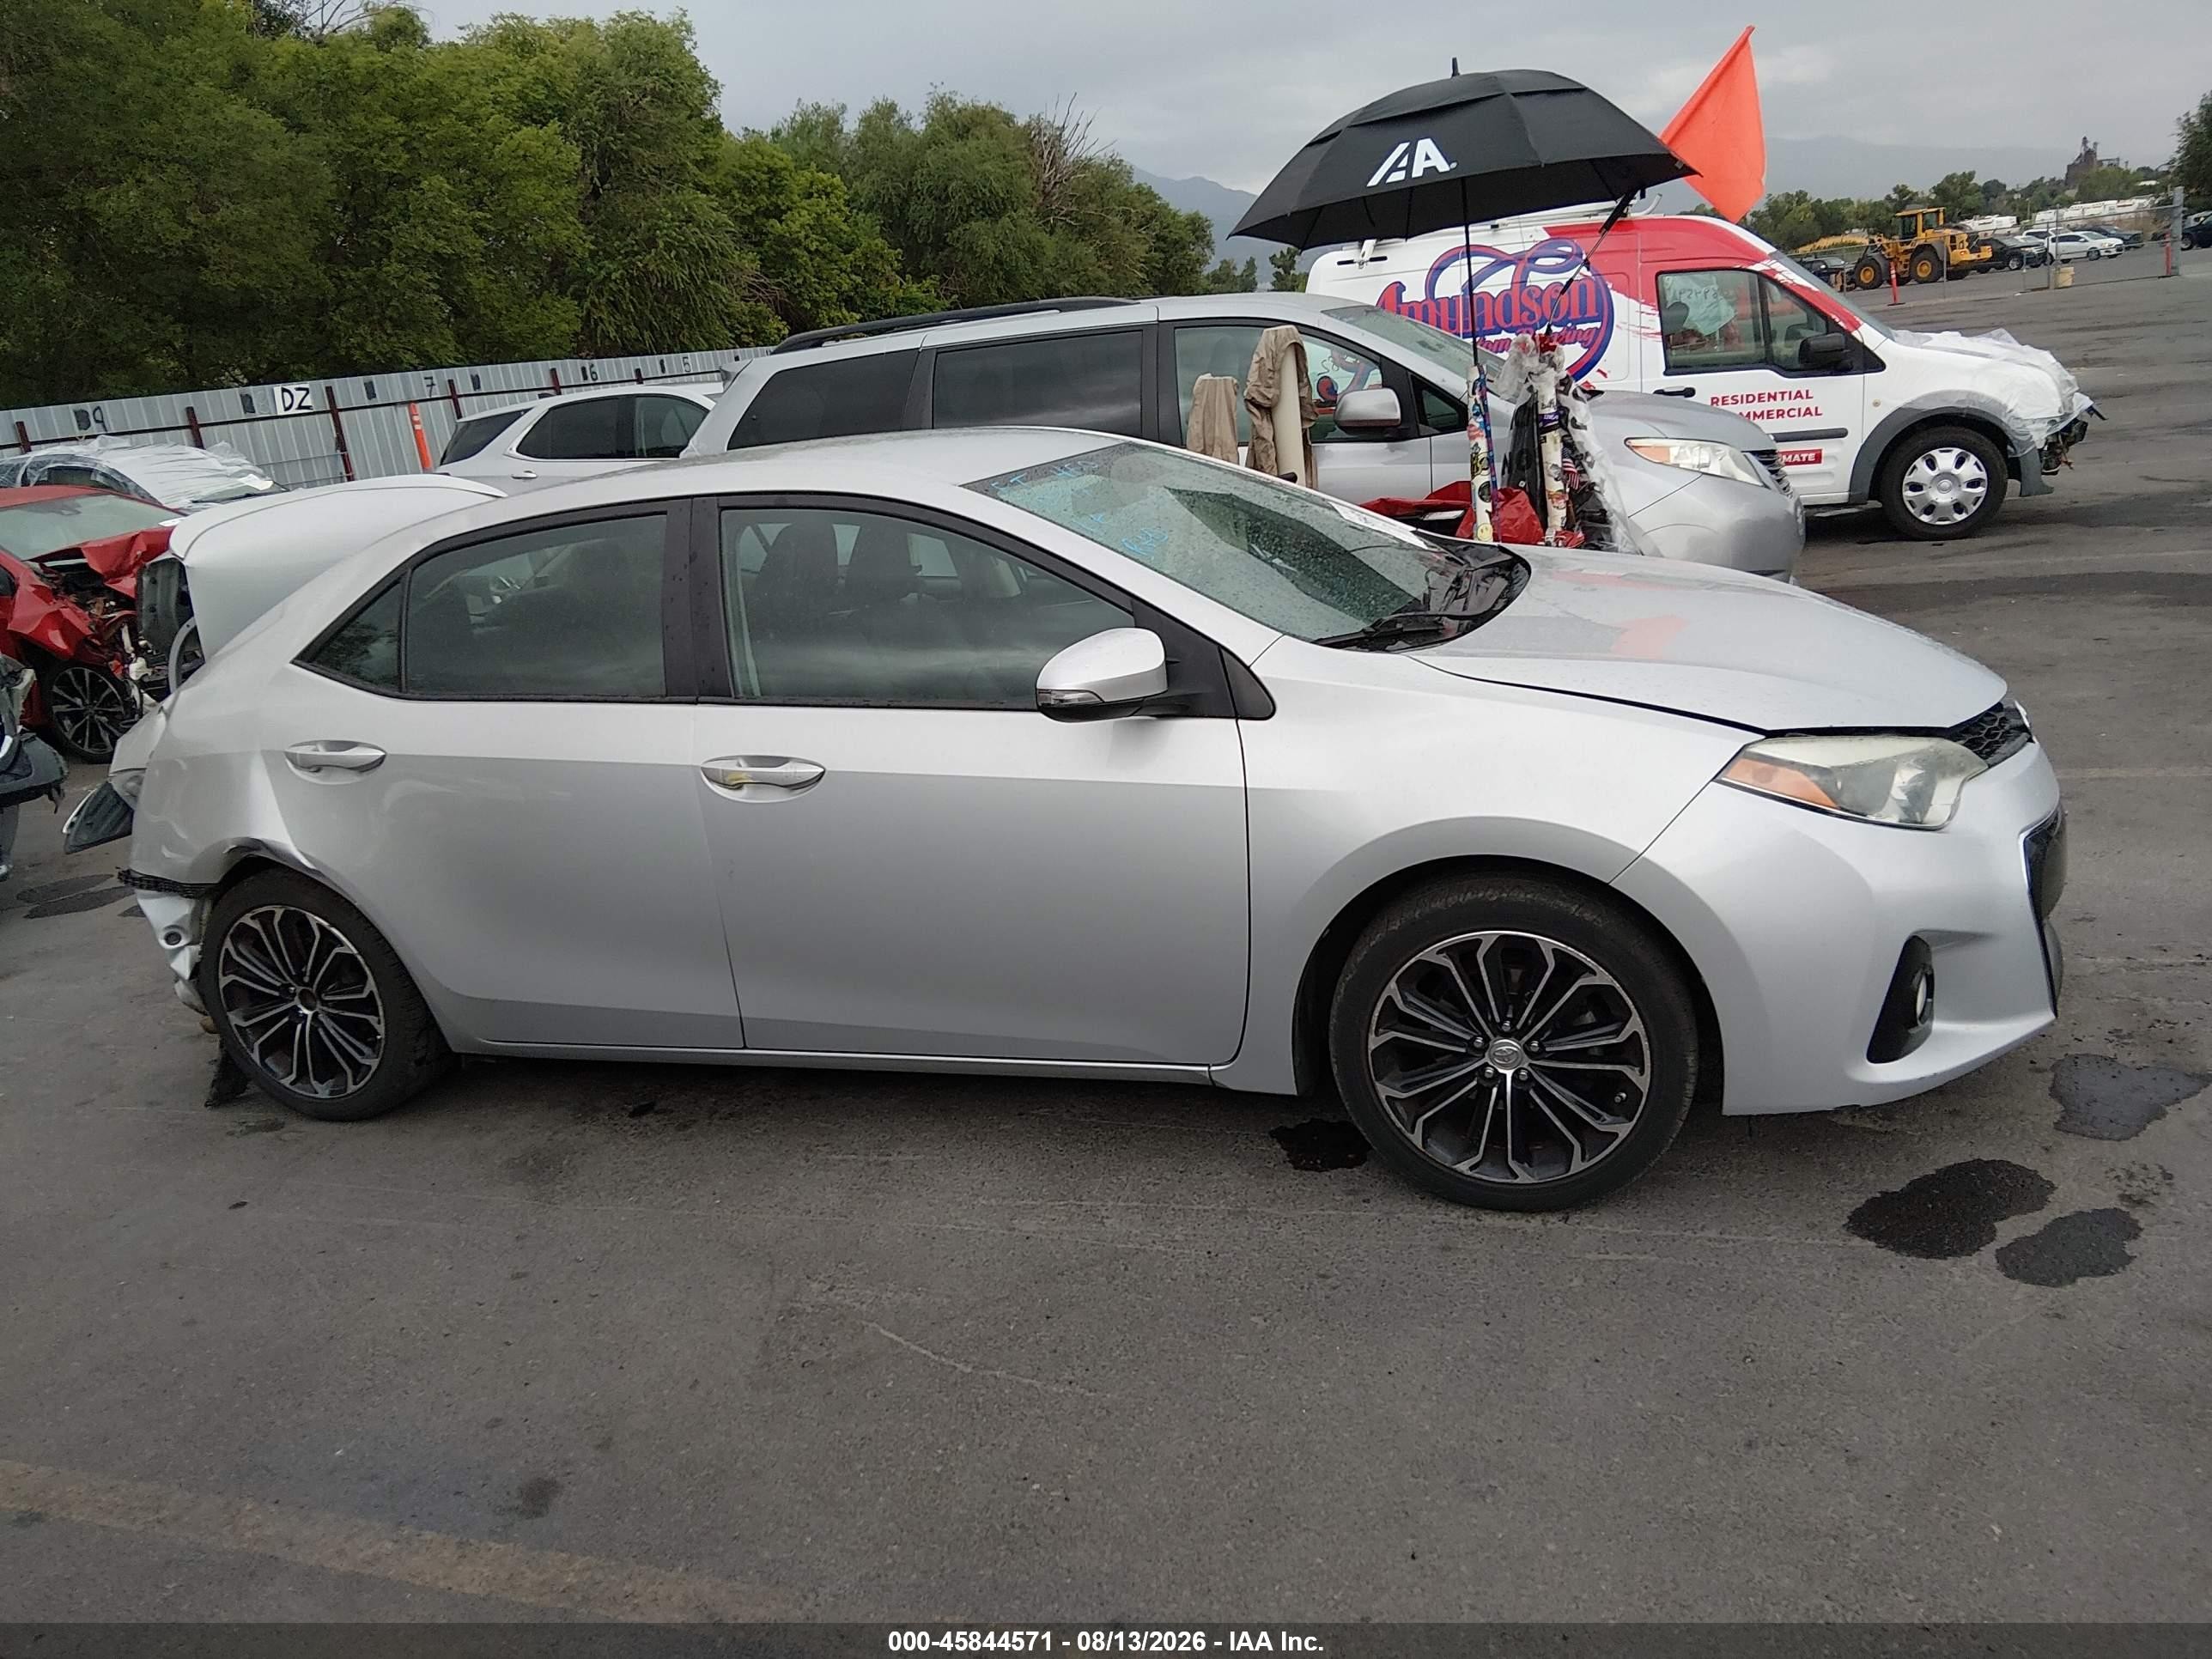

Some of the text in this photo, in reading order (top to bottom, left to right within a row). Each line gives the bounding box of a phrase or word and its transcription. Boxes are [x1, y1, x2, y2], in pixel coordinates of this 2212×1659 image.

[1710, 389, 1814, 407] RESIDENTIAL
[1738, 406, 1824, 422] MMERCIAL
[1781, 453, 1816, 463] MATE
